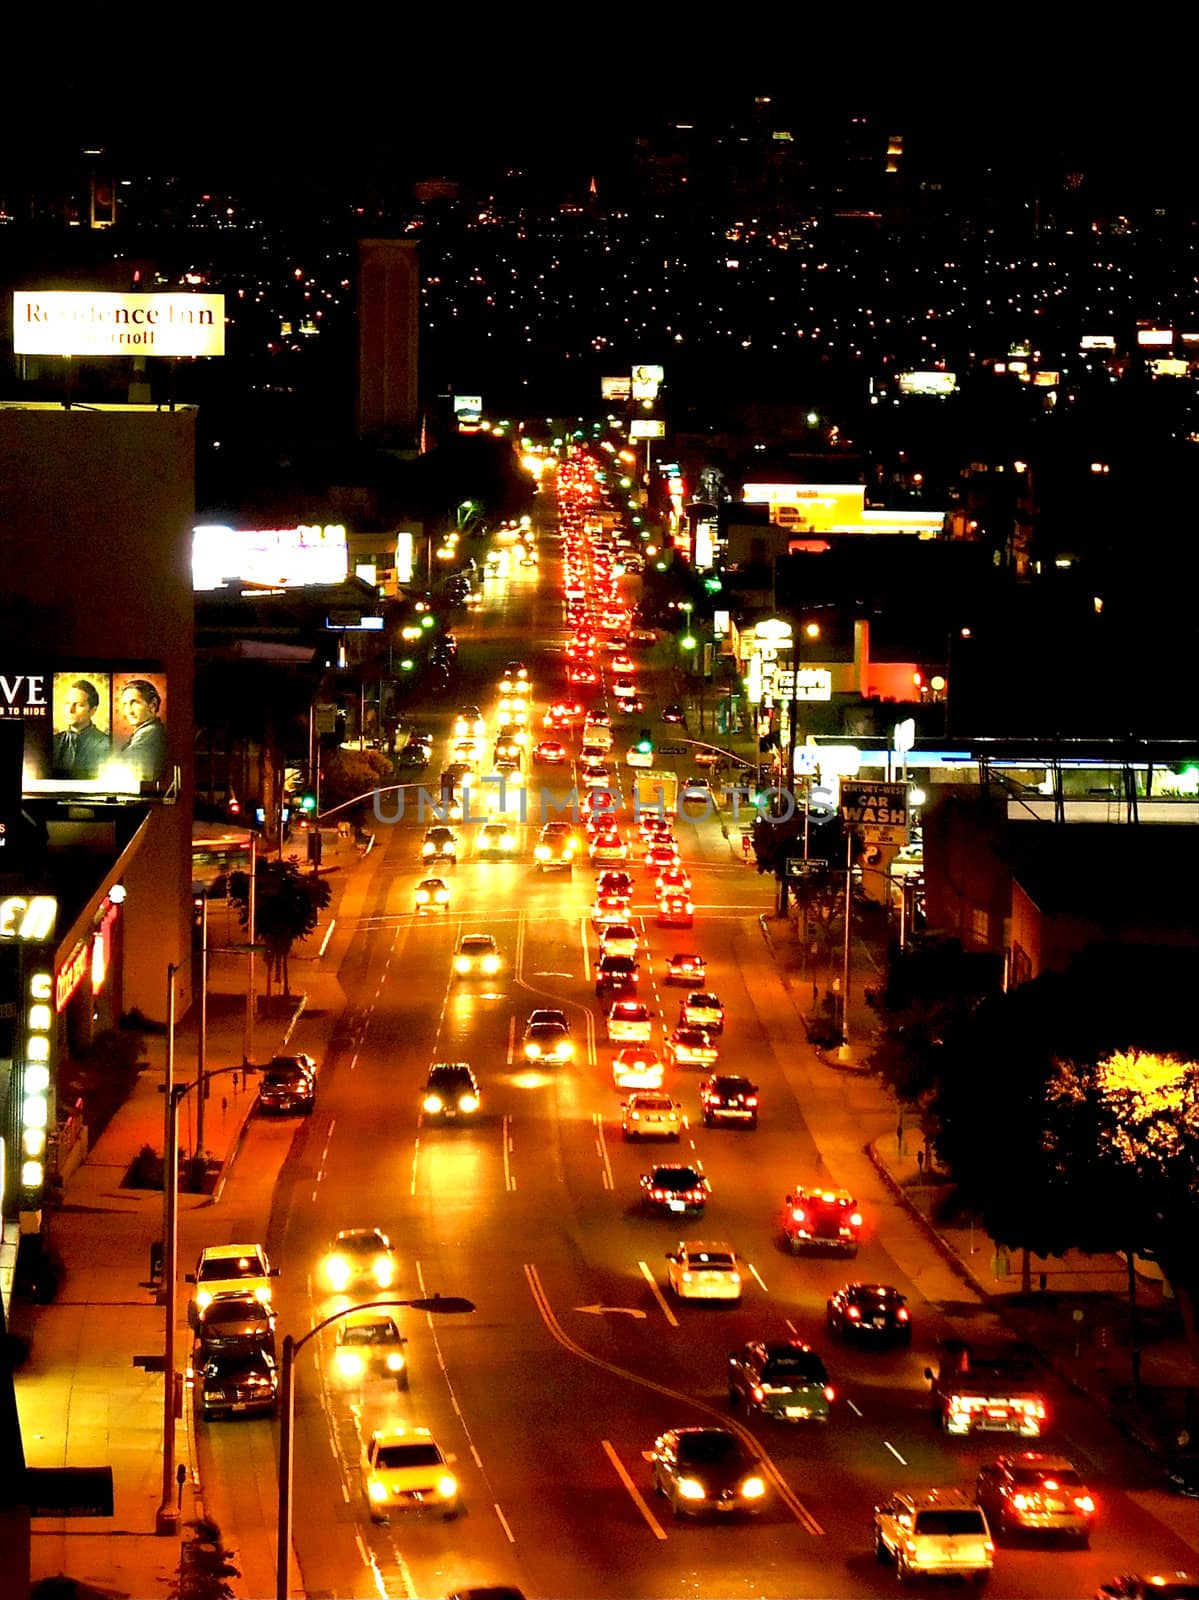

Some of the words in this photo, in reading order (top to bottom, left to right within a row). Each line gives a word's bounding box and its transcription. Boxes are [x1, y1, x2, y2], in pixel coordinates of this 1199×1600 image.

[8, 706, 20, 716] TO
[23, 706, 46, 716] HIDE
[858, 795, 889, 808] CAR
[842, 806, 905, 824] WASH
